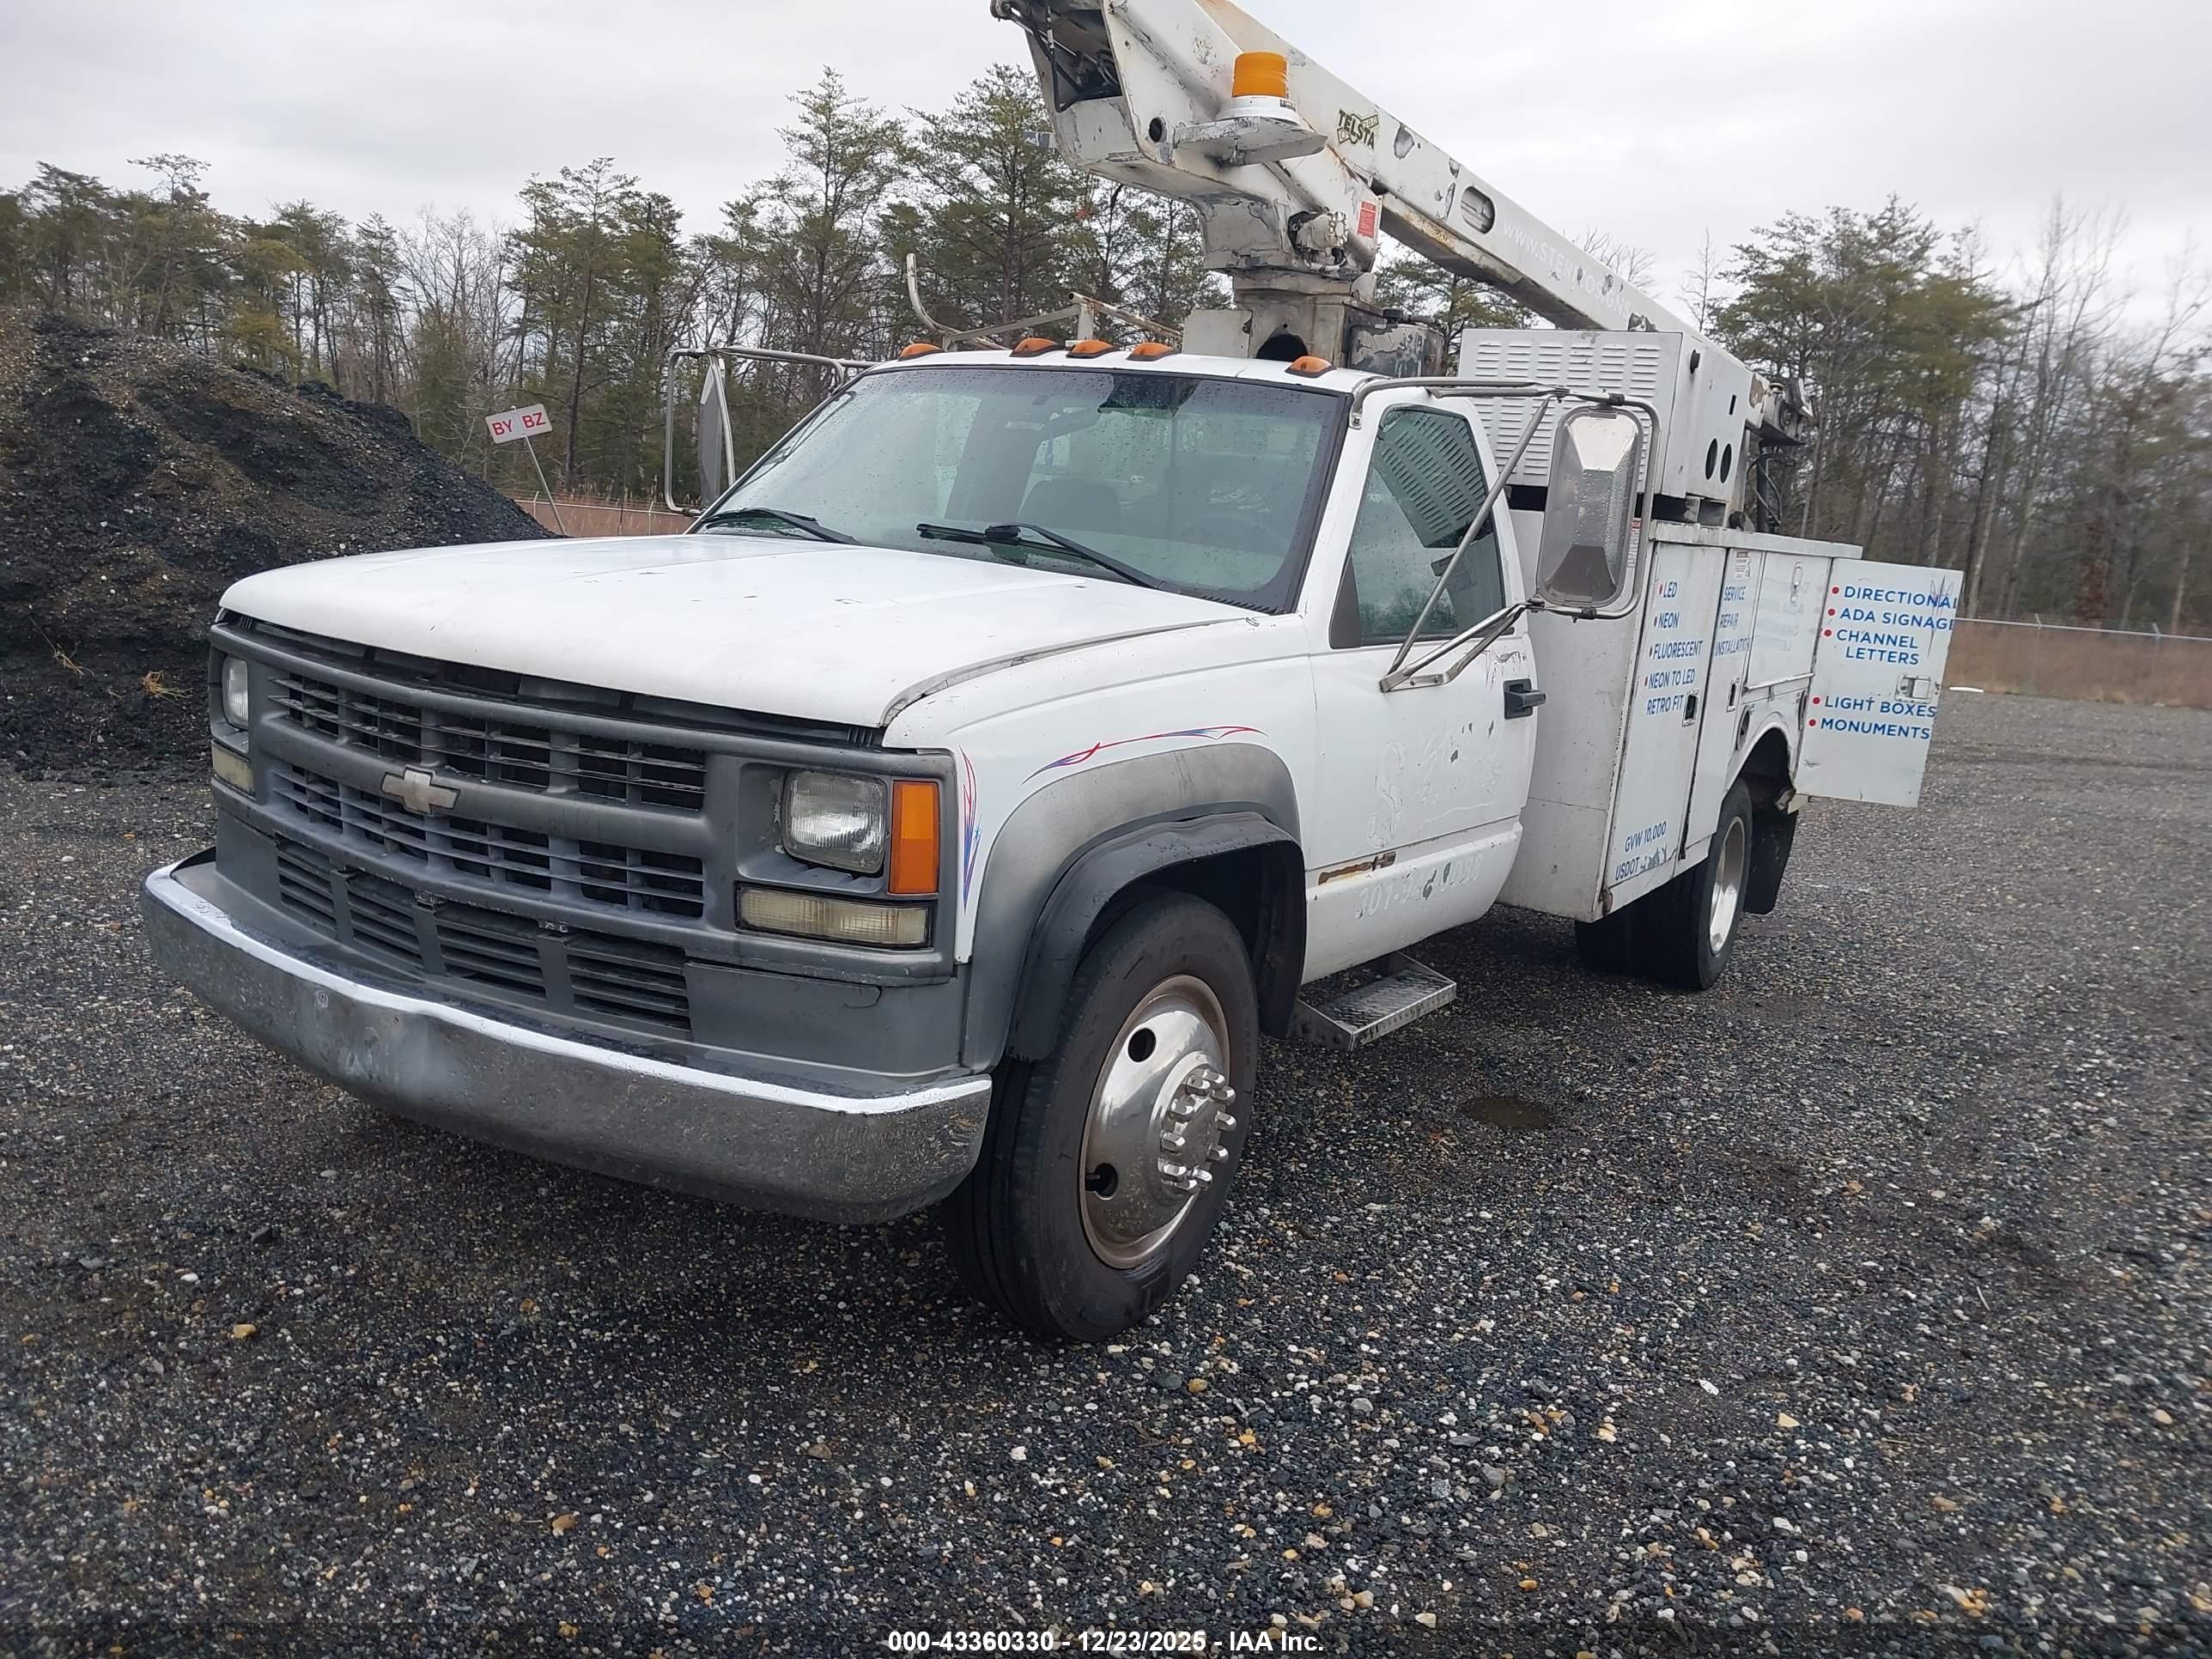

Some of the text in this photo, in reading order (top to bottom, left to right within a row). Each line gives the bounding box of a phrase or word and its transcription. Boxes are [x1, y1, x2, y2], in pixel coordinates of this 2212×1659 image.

[492, 412, 546, 435] BY BZ
[1663, 581, 1678, 598] LED
[1723, 586, 1747, 601] SERVICE
[1658, 612, 1680, 629] NEON
[1719, 612, 1739, 629] REPAIR
[1839, 608, 1875, 623] ADA
[1837, 629, 1919, 649] CHANNEL
[1653, 640, 1704, 660] FLUORESCENT
[1845, 647, 1919, 665] LETTERS
[1649, 668, 1696, 690] NEON TO LED
[1646, 694, 1685, 715] RETRO FIT
[1824, 696, 1938, 718] LIGHT BOXES
[1820, 718, 1930, 739] MONUMENTS
[1625, 821, 1667, 853] GVW 10,000
[1615, 857, 1640, 881] USDOT
